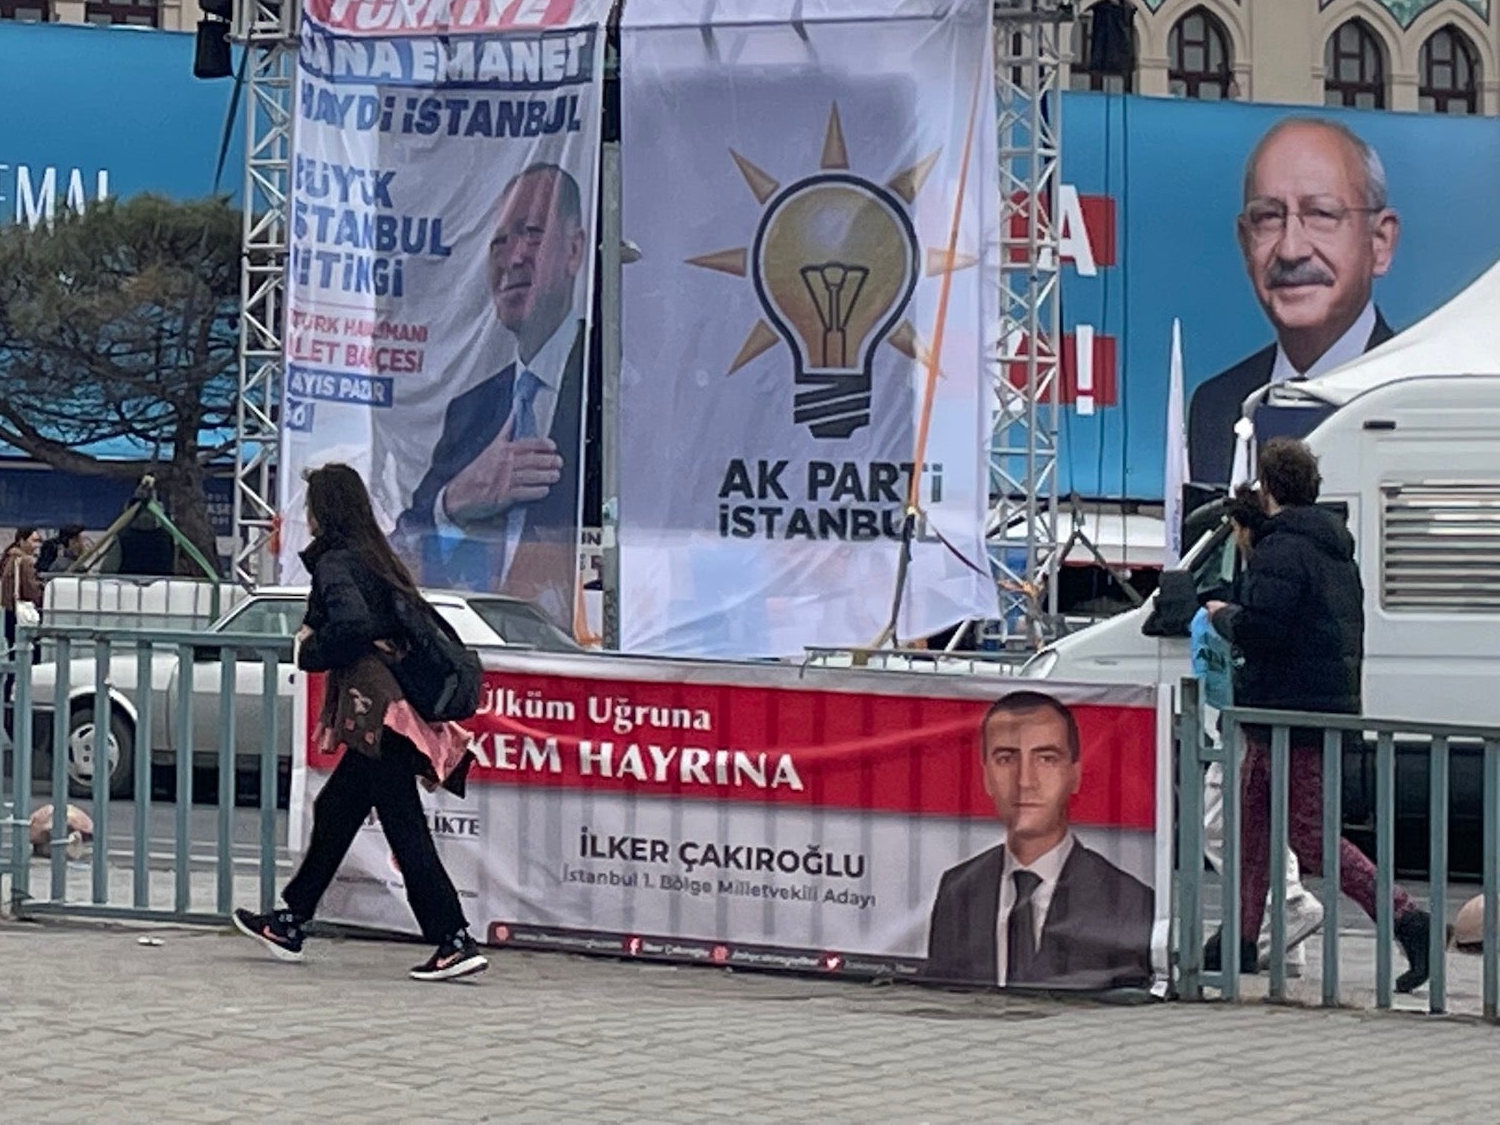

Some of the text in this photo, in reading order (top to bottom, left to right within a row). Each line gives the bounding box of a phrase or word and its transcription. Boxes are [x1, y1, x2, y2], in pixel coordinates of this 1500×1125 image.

[412, 36, 588, 82] EMANET
[718, 458, 944, 504] AK PARTİ
[718, 503, 946, 542] İSTANBUL
[587, 695, 712, 734] Uğruna
[578, 739, 804, 792] HAYRINA
[579, 825, 866, 878] İLKER ÇAKIROĞLU
